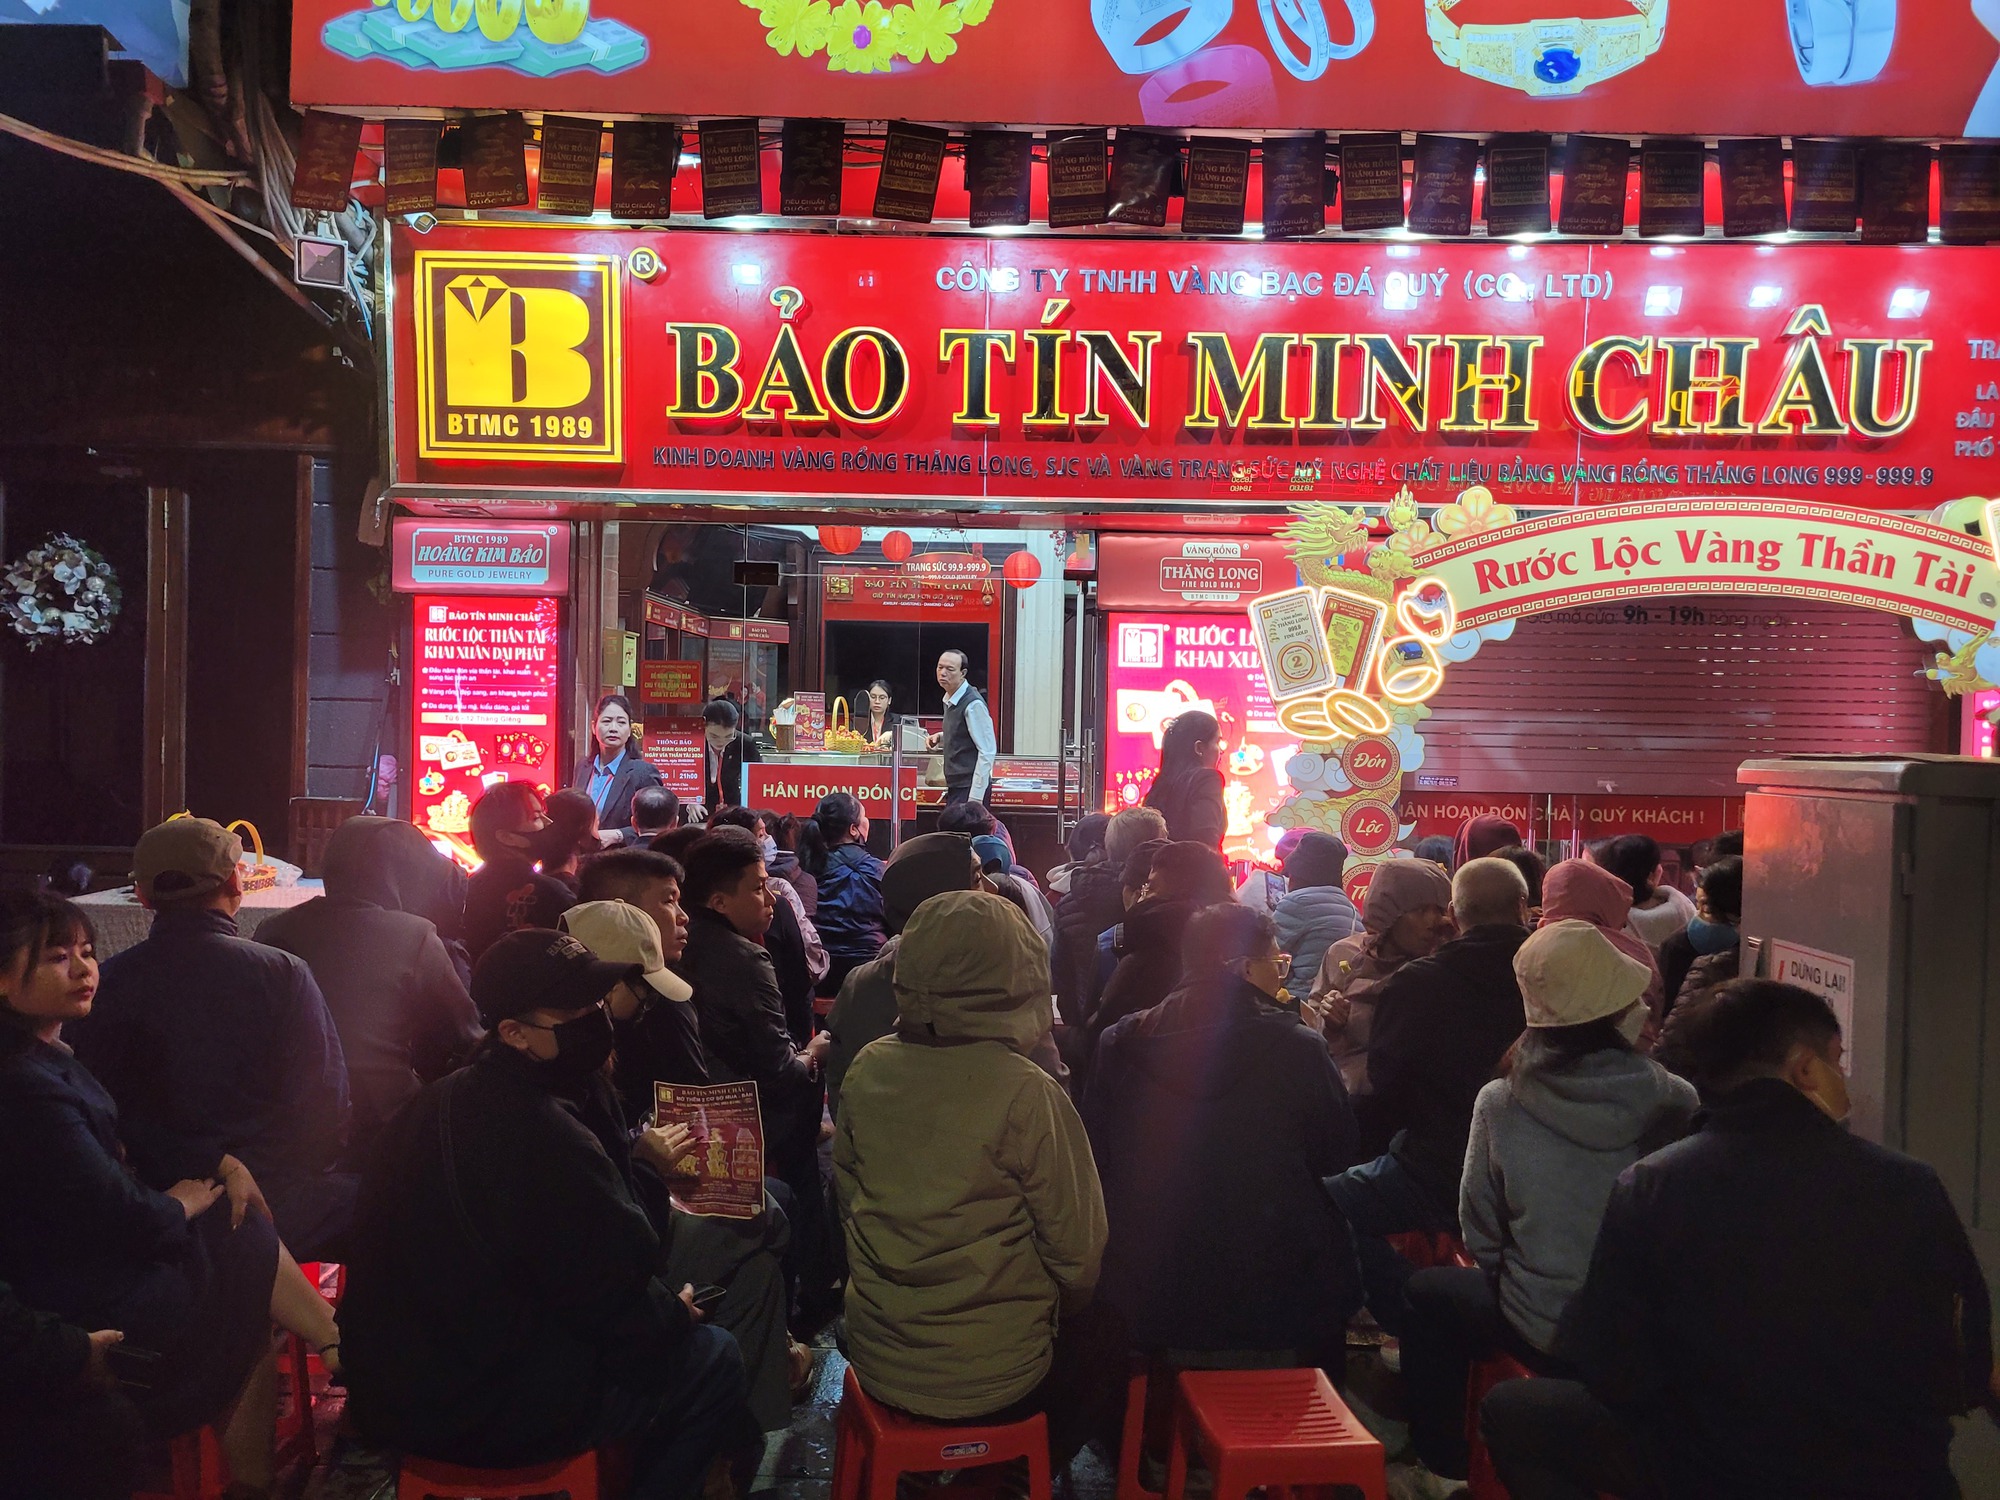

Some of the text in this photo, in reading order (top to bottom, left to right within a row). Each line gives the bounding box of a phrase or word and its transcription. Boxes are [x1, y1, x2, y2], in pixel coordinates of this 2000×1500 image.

[936, 261, 1019, 293] CÔNG
[1030, 268, 1068, 293] TY
[1079, 269, 1157, 295] TNHH
[1169, 265, 1247, 295] VÀNG
[1261, 271, 1322, 302] BẠC
[1333, 266, 1375, 297] ĐÁ
[1384, 267, 1450, 298] QUÝ
[1545, 270, 1613, 300] LTD)
[665, 286, 1933, 437] BẢO TÍN MINH CHÂU
[1976, 380, 2000, 401] LÀ
[447, 414, 593, 440] BTMC 1989
[1954, 435, 1994, 458] PHỐ
[653, 445, 699, 467] KINH
[704, 447, 775, 470] DOANH
[781, 446, 835, 471] VÀNG
[841, 445, 898, 472] RỒNG
[903, 450, 972, 476] THĂNG
[977, 455, 1039, 478] LONG,
[1046, 456, 1081, 477] SJC
[1087, 451, 1112, 478] VÀ
[1120, 451, 1175, 479] VÀNG
[1179, 457, 1245, 480] TRANG
[1250, 456, 1290, 480] SỨC
[1294, 457, 1324, 480] MỸ
[1331, 457, 1386, 485] NGHỆ
[1391, 457, 1446, 482] CHẤT
[1450, 460, 1492, 486] LIỆU
[1498, 457, 1554, 483] BẰNG
[1561, 459, 1616, 484] VÀNG
[1621, 457, 1678, 484] RỒNG
[1685, 458, 1756, 485] THĂNG
[1763, 466, 1819, 486] LONG
[454, 534, 509, 545] BTMC 1989
[417, 541, 544, 564] HOÀNG KIM BẢO
[1186, 544, 1238, 555] VÀNG RỒNG
[905, 562, 932, 572] TRANG
[932, 561, 947, 572] SỨC
[1163, 563, 1259, 581] THĂNG LONG
[1472, 528, 1976, 599] Rước Lộc Vàng Thần Tài
[428, 569, 532, 580] PURE GOLD JEWELRY
[1181, 580, 1197, 588] FINE
[448, 611, 541, 622] BẢO TÍN MINH CHÂU
[1623, 604, 1648, 624] 9h
[1669, 605, 1705, 625] 19h
[425, 626, 460, 642] RƯỚC
[462, 627, 487, 644] LỘC
[526, 628, 546, 644] TÀI
[1175, 624, 1234, 646] RƯỚC
[424, 646, 455, 659] KHAI
[457, 645, 490, 659] XUÂN
[514, 645, 546, 661] PHÁT
[1175, 650, 1224, 667] KHAI
[1291, 655, 1302, 668] 2
[1353, 752, 1387, 769] Đón
[762, 779, 798, 799] HÂN
[857, 779, 893, 801] ĐÓN
[1589, 804, 1627, 824] QUÝ
[1632, 805, 1694, 824] KHÁCH
[1355, 817, 1384, 837] Lộc
[1352, 884, 1368, 901] Th
